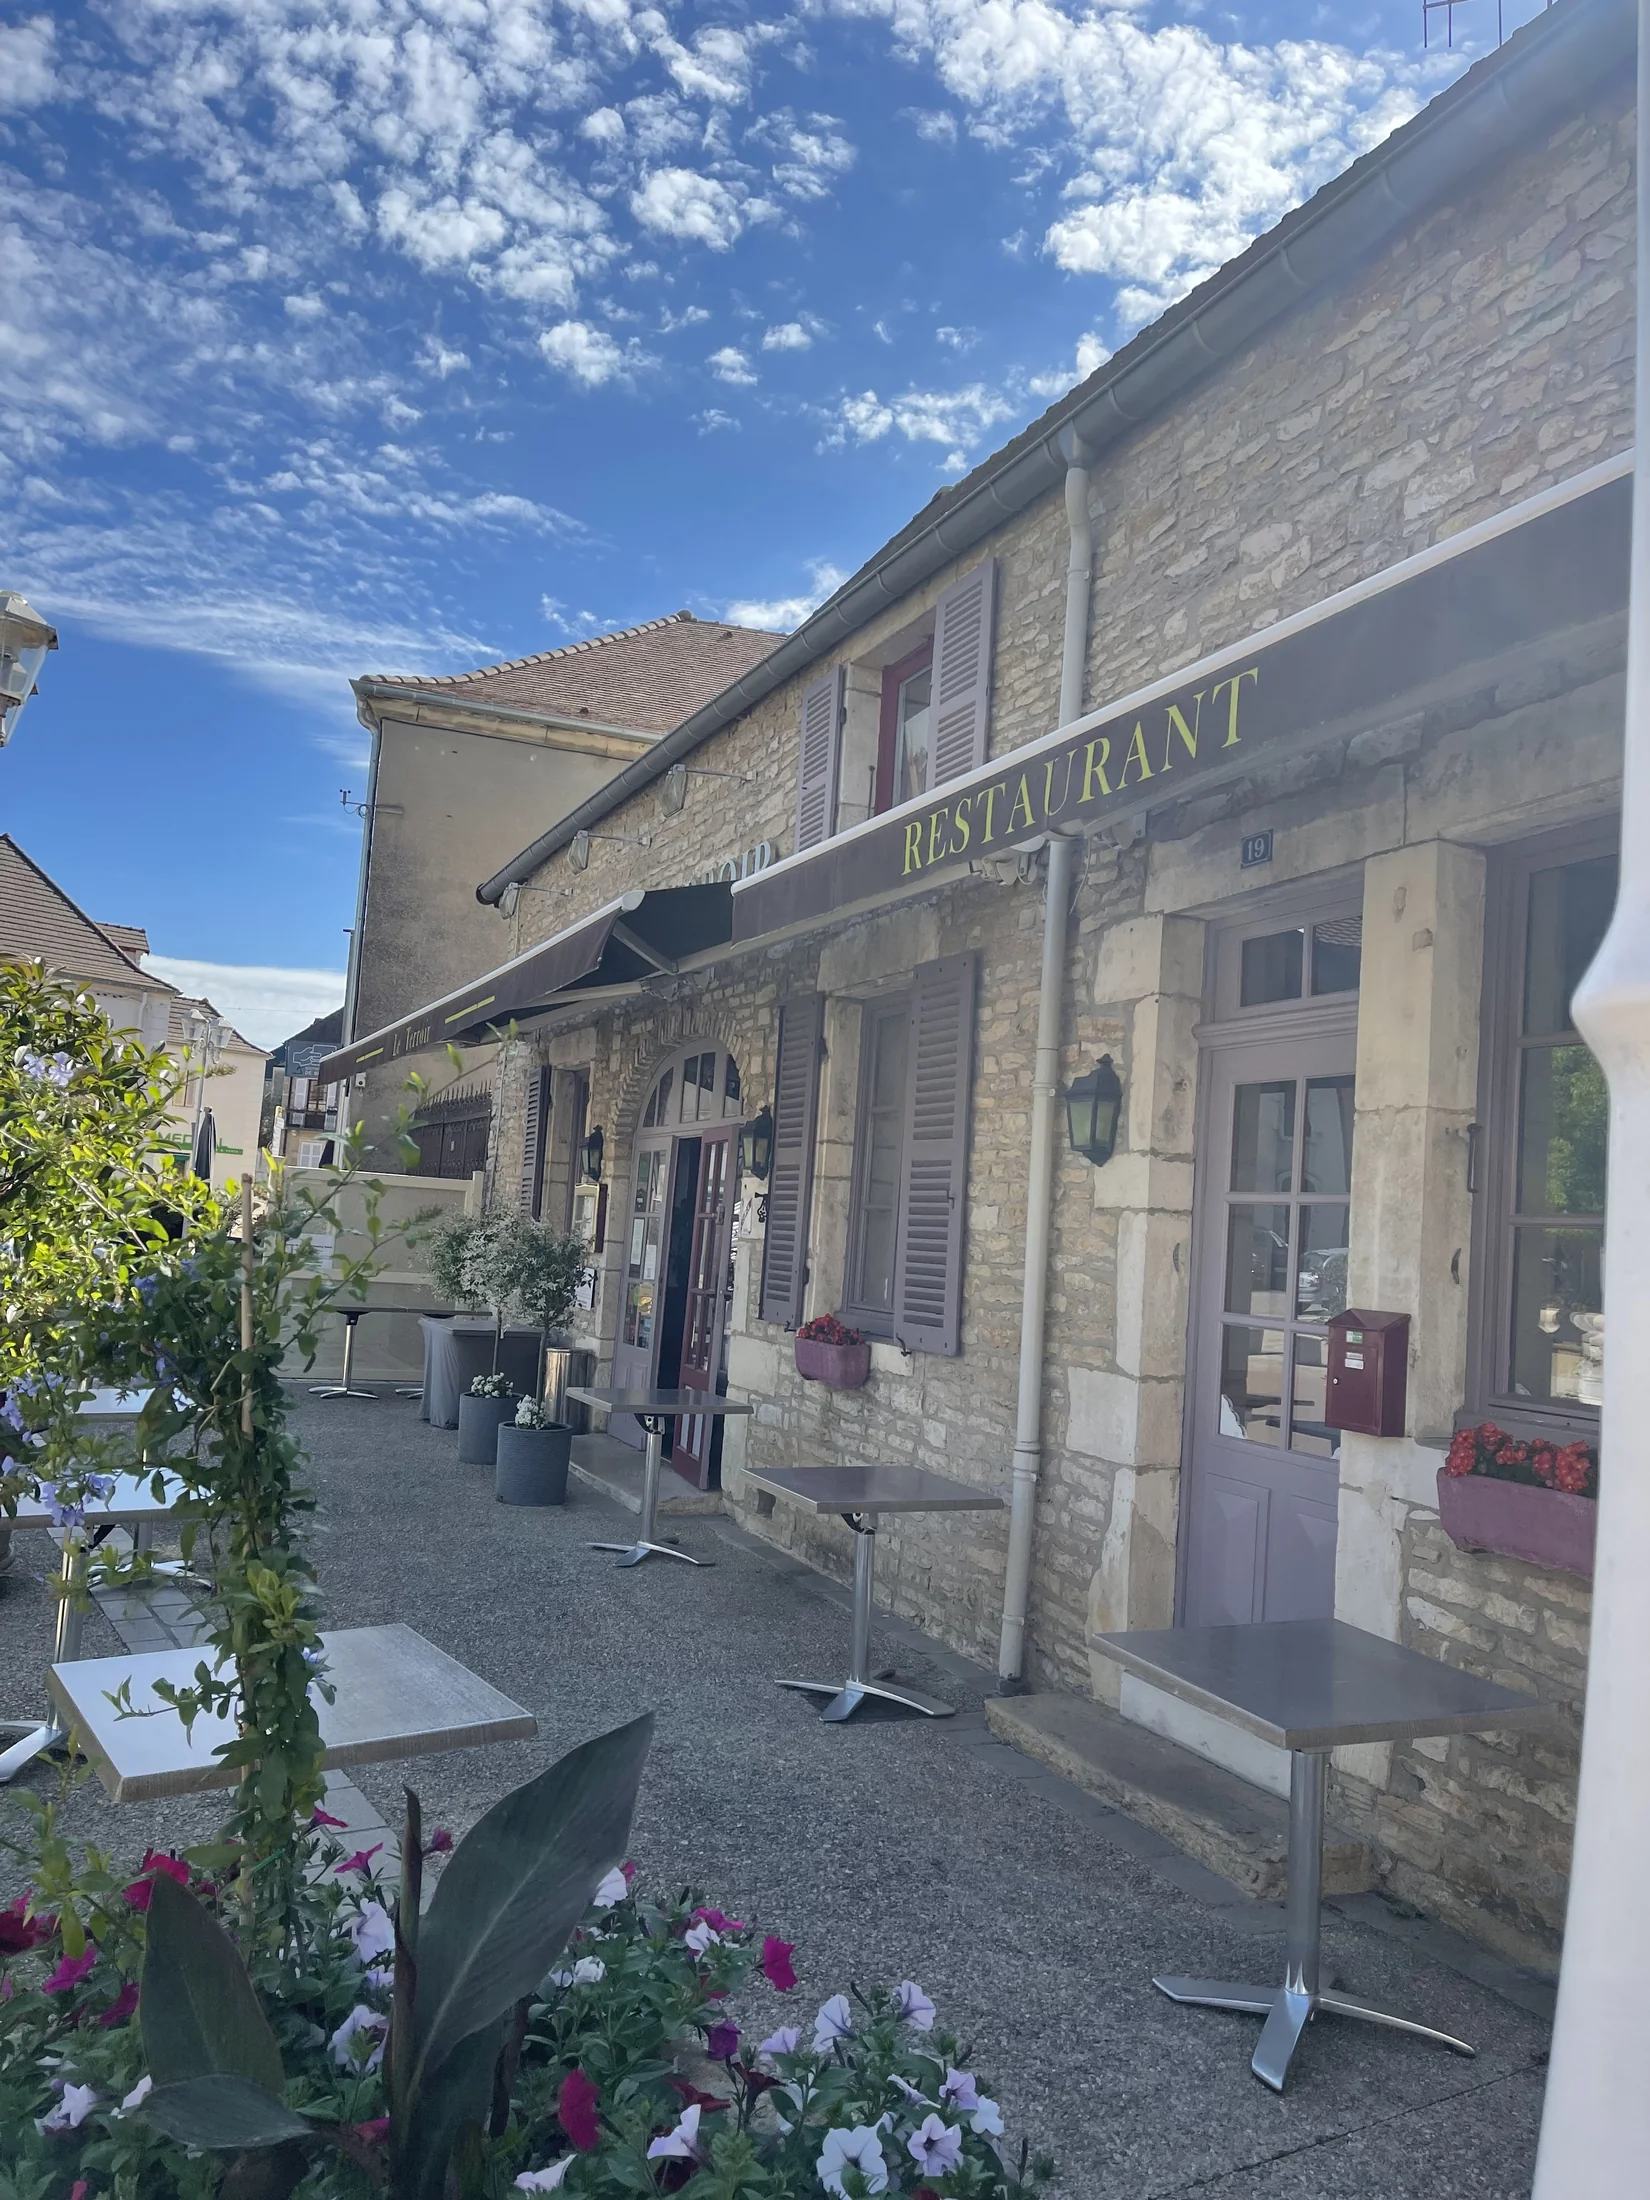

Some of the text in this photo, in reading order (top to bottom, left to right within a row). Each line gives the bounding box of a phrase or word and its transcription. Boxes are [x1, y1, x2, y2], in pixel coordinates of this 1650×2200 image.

[901, 666, 1259, 876] RESTAURANT
[1247, 838, 1265, 861] 19
[392, 1020, 431, 1056] Le Terroir
